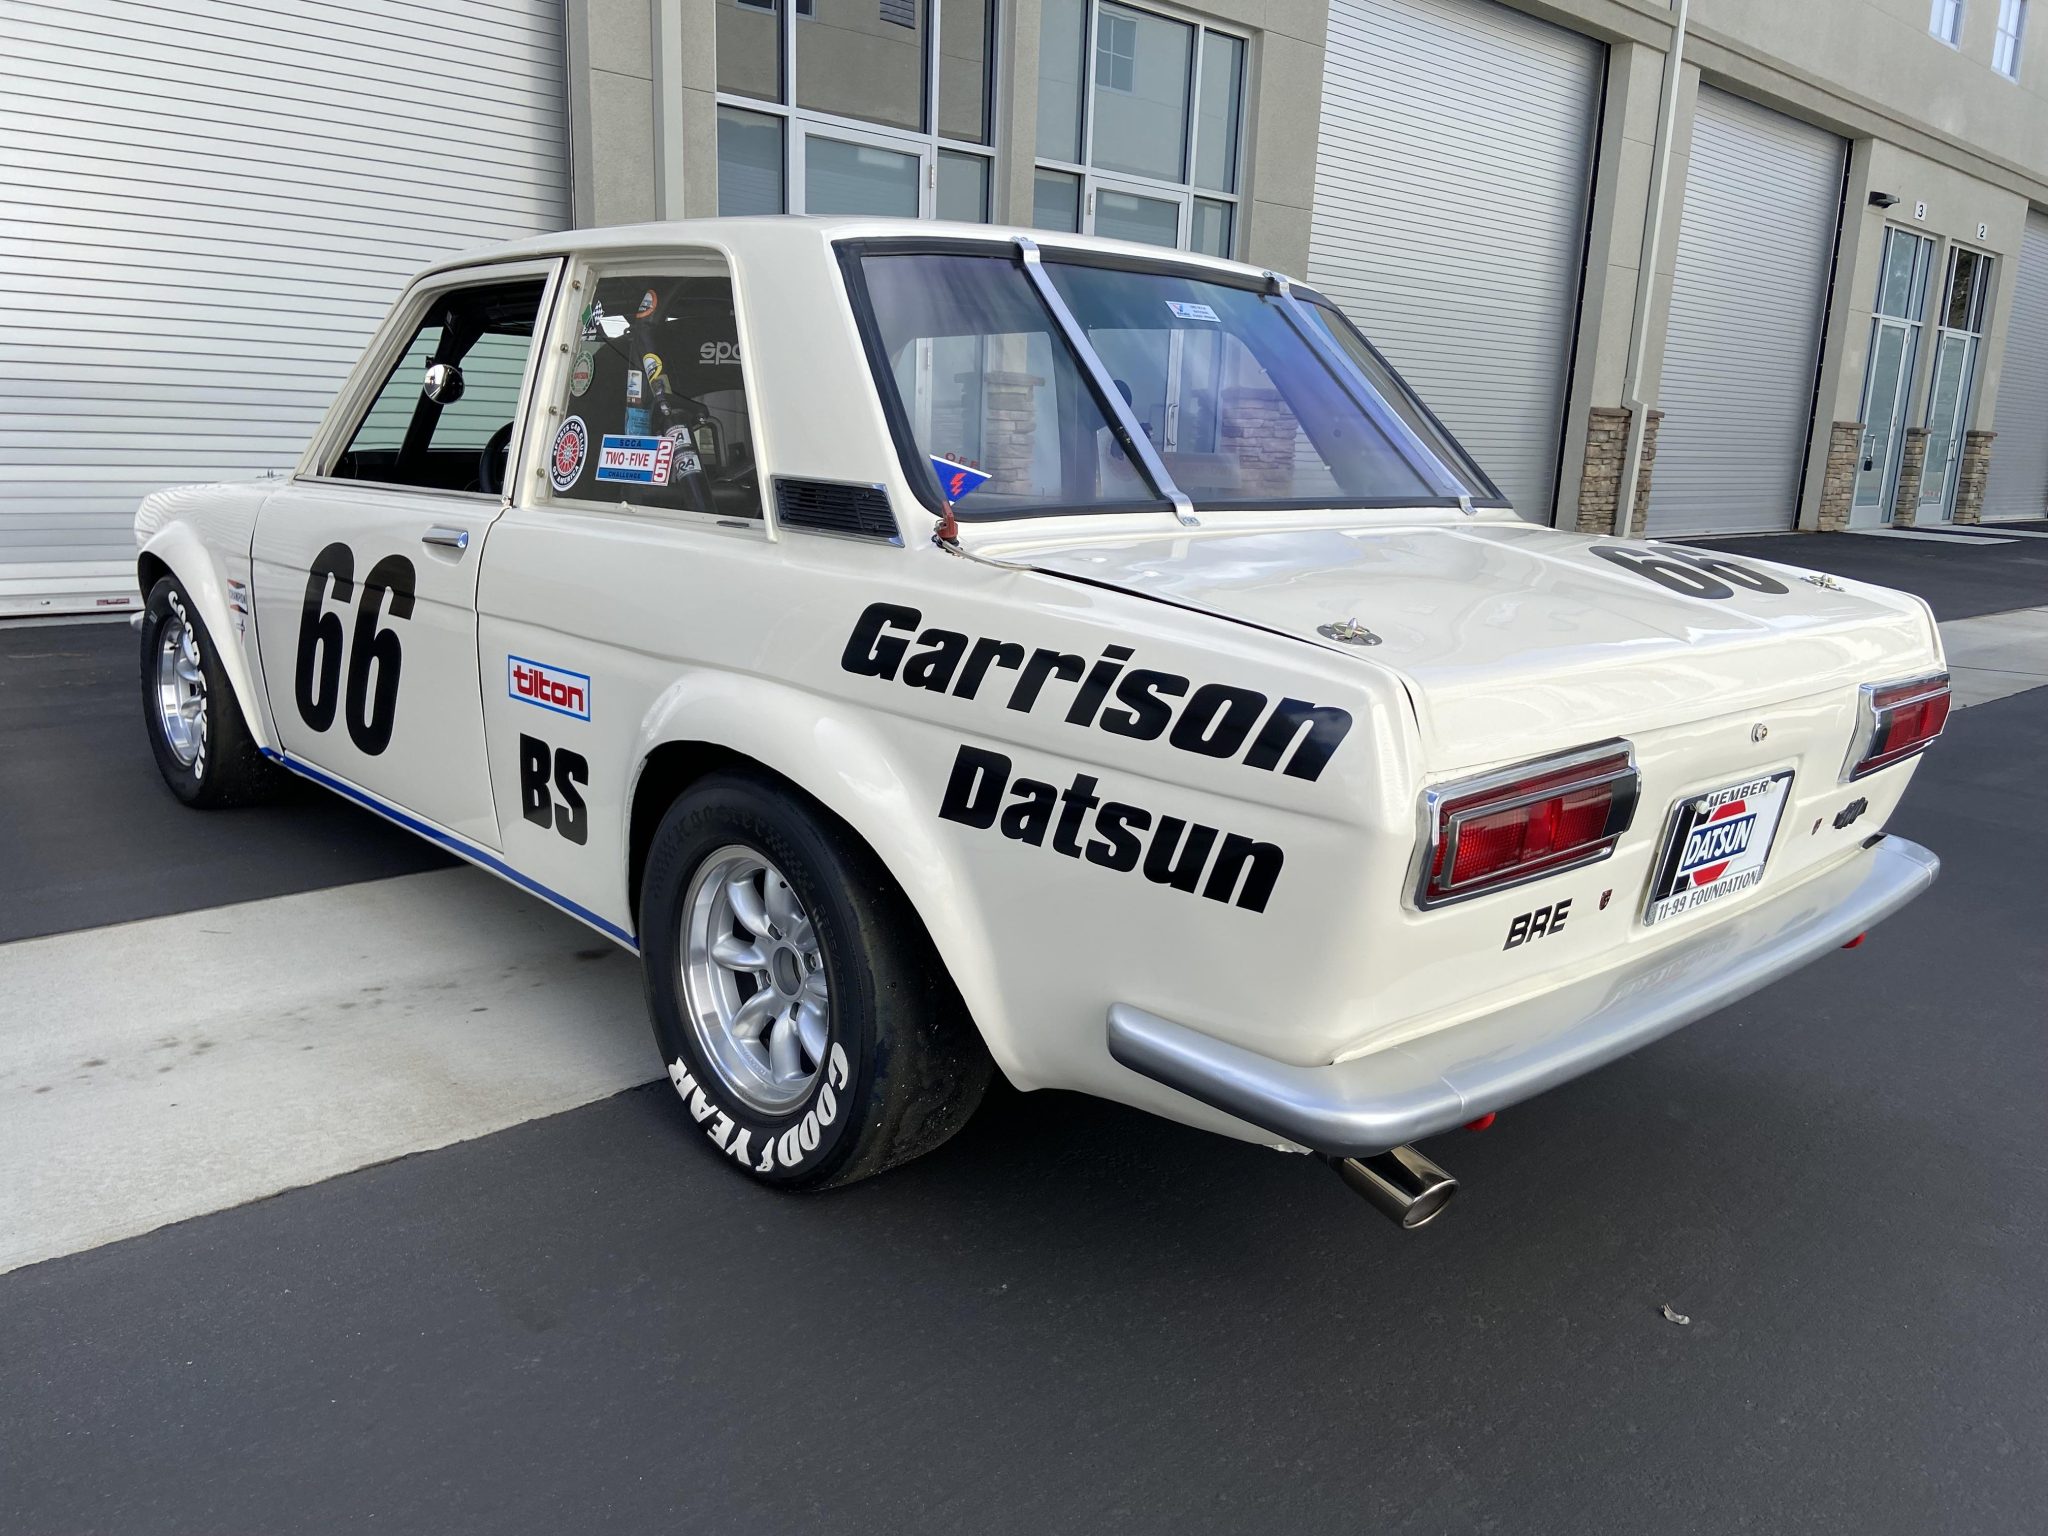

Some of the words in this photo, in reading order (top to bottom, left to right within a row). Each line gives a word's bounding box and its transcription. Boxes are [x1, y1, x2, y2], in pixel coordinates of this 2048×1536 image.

[553, 425, 570, 456] SPORTS
[570, 422, 581, 433] CAR
[619, 439, 642, 448] SCCA
[556, 465, 580, 485] AMERICA
[1588, 545, 1790, 600] 66
[295, 541, 416, 756] 66
[513, 664, 584, 712] tilton
[841, 602, 1353, 782] Garrison
[519, 732, 589, 845] BS
[1708, 779, 1769, 808] MEMBER
[938, 744, 1284, 914] Datsun
[1685, 817, 1755, 867] DATSUN
[1658, 896, 1688, 922] 11-99
[1689, 868, 1759, 908] FOUNDATION
[1502, 897, 1573, 951] BRE
